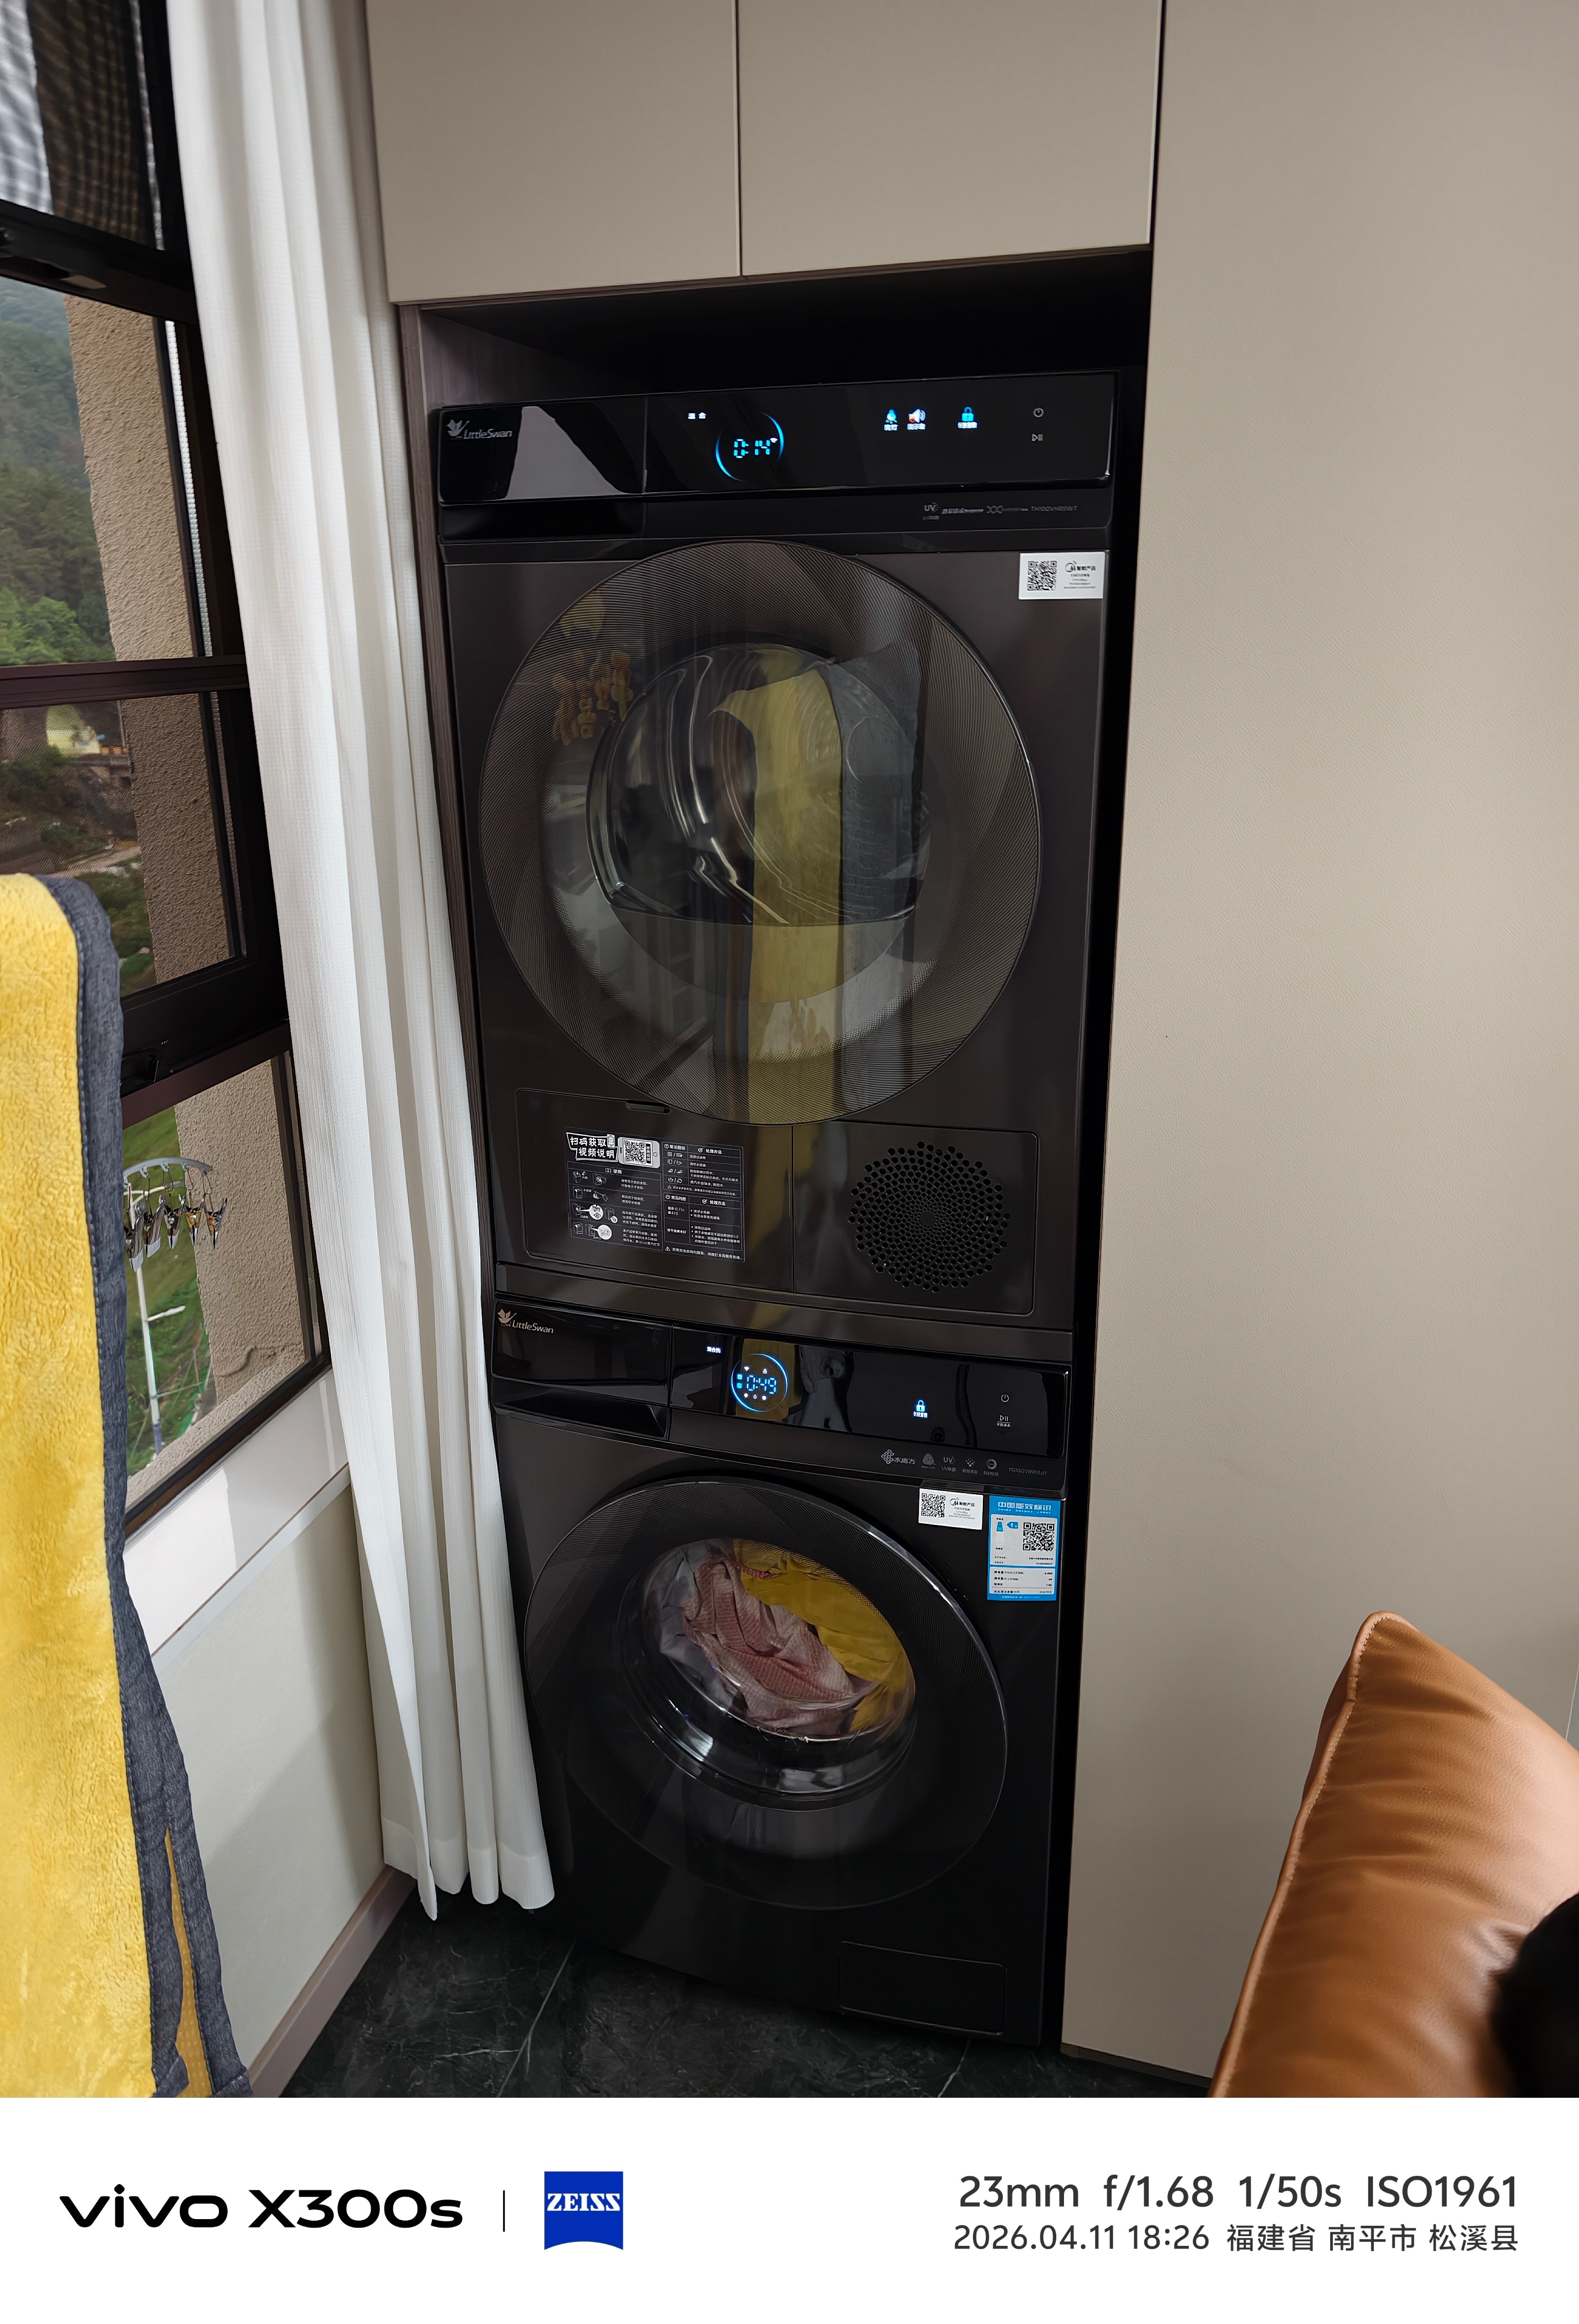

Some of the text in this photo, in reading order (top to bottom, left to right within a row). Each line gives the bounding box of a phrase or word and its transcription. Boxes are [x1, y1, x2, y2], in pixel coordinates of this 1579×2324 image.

[570, 1136, 607, 1147] 扫码获取
[579, 1148, 614, 1158] 视频说明
[512, 1320, 554, 1334] LittleSwan
[746, 1375, 777, 1394] 0:49
[998, 1502, 1052, 1511] 中国能效标识
